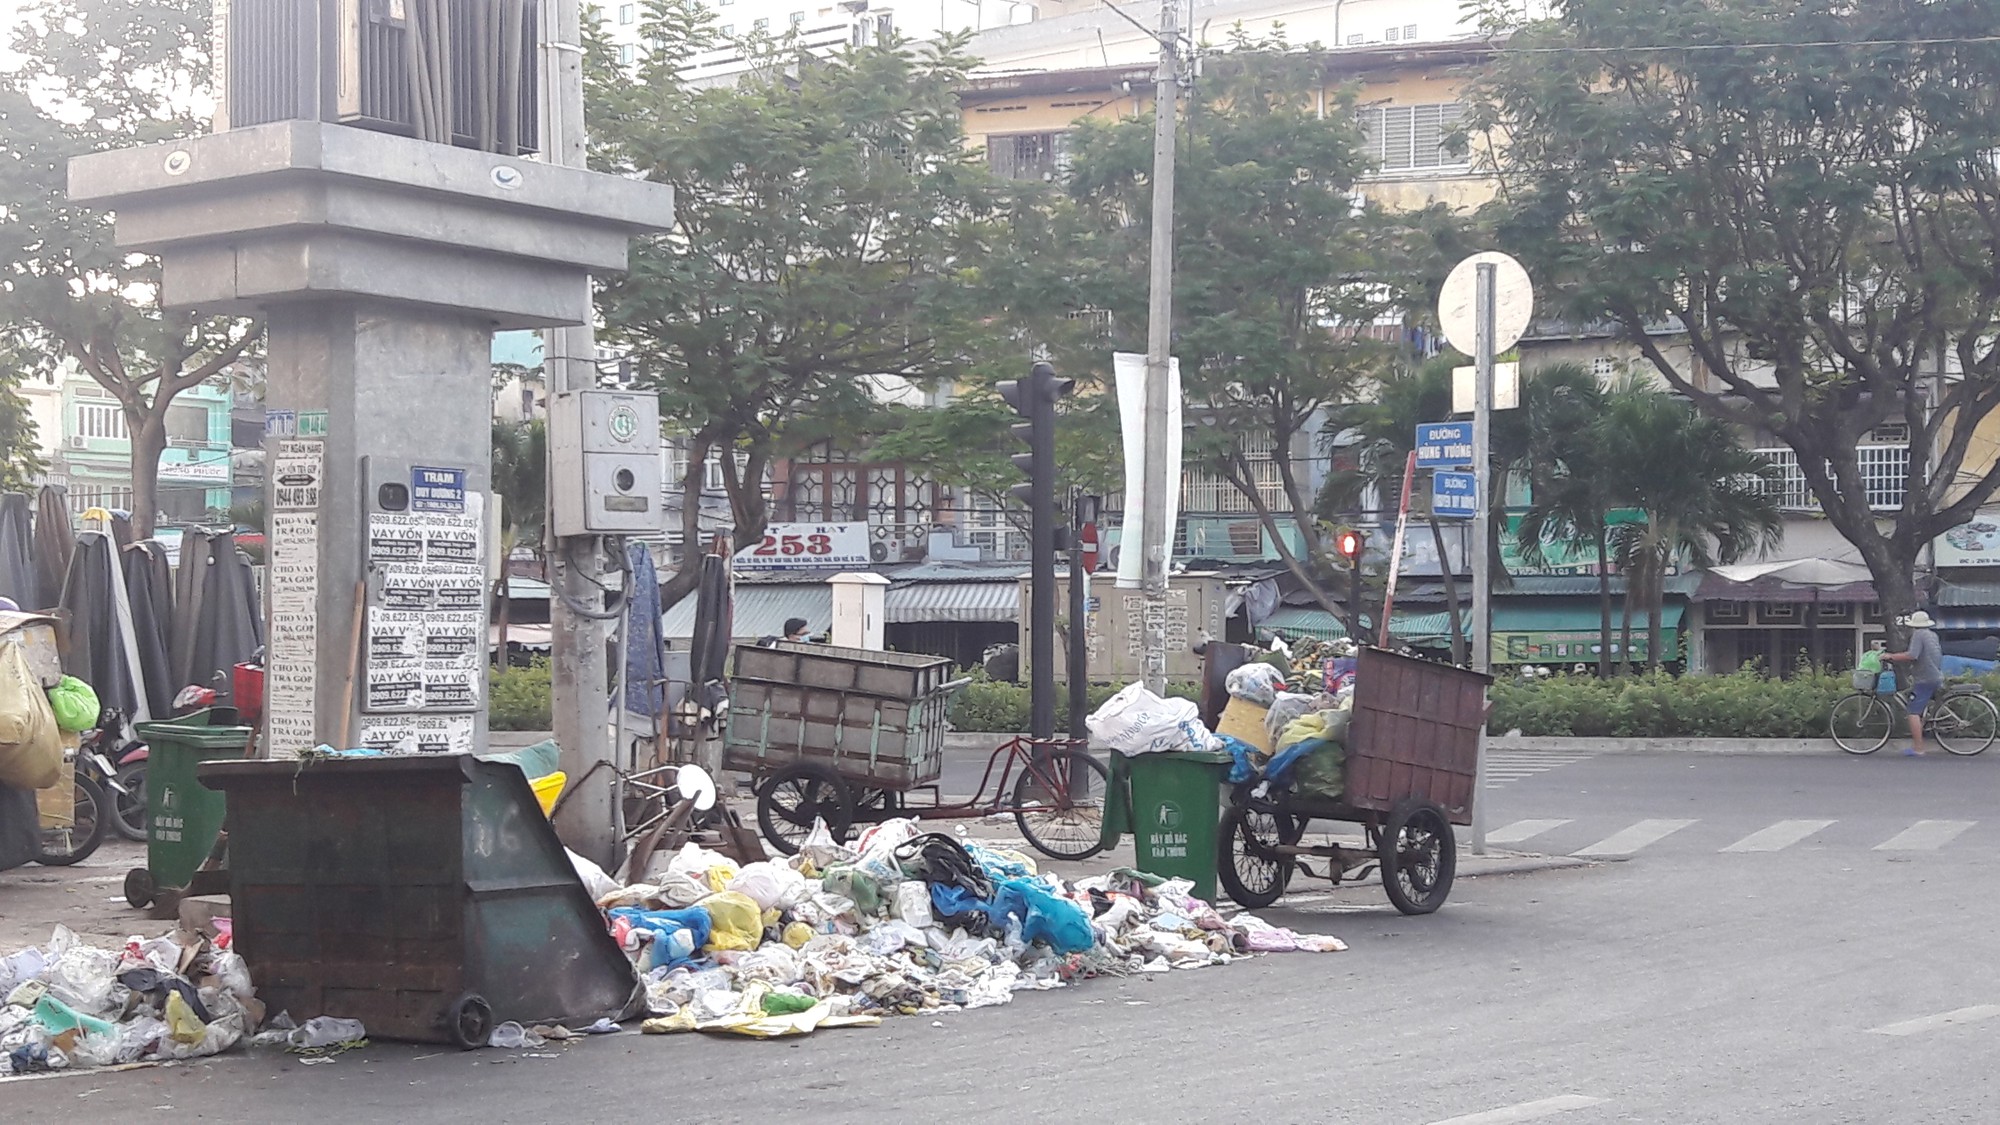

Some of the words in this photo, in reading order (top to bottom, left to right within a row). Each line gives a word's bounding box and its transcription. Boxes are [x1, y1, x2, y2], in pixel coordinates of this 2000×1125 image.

[423, 472, 455, 485] TRẠM
[372, 529, 397, 539] VAY
[398, 526, 423, 539] VỐN
[428, 530, 452, 540] VAY
[453, 527, 476, 540] VỐN
[753, 534, 833, 555] 253
[410, 575, 434, 588] VỐN
[434, 579, 457, 587] VAY
[372, 626, 396, 635] VAY
[427, 627, 451, 635] VAY
[453, 624, 476, 636] VỐN
[370, 674, 394, 682] VAY
[397, 668, 421, 682] VỐN
[426, 674, 448, 683] VAY
[418, 734, 442, 742] VAY
